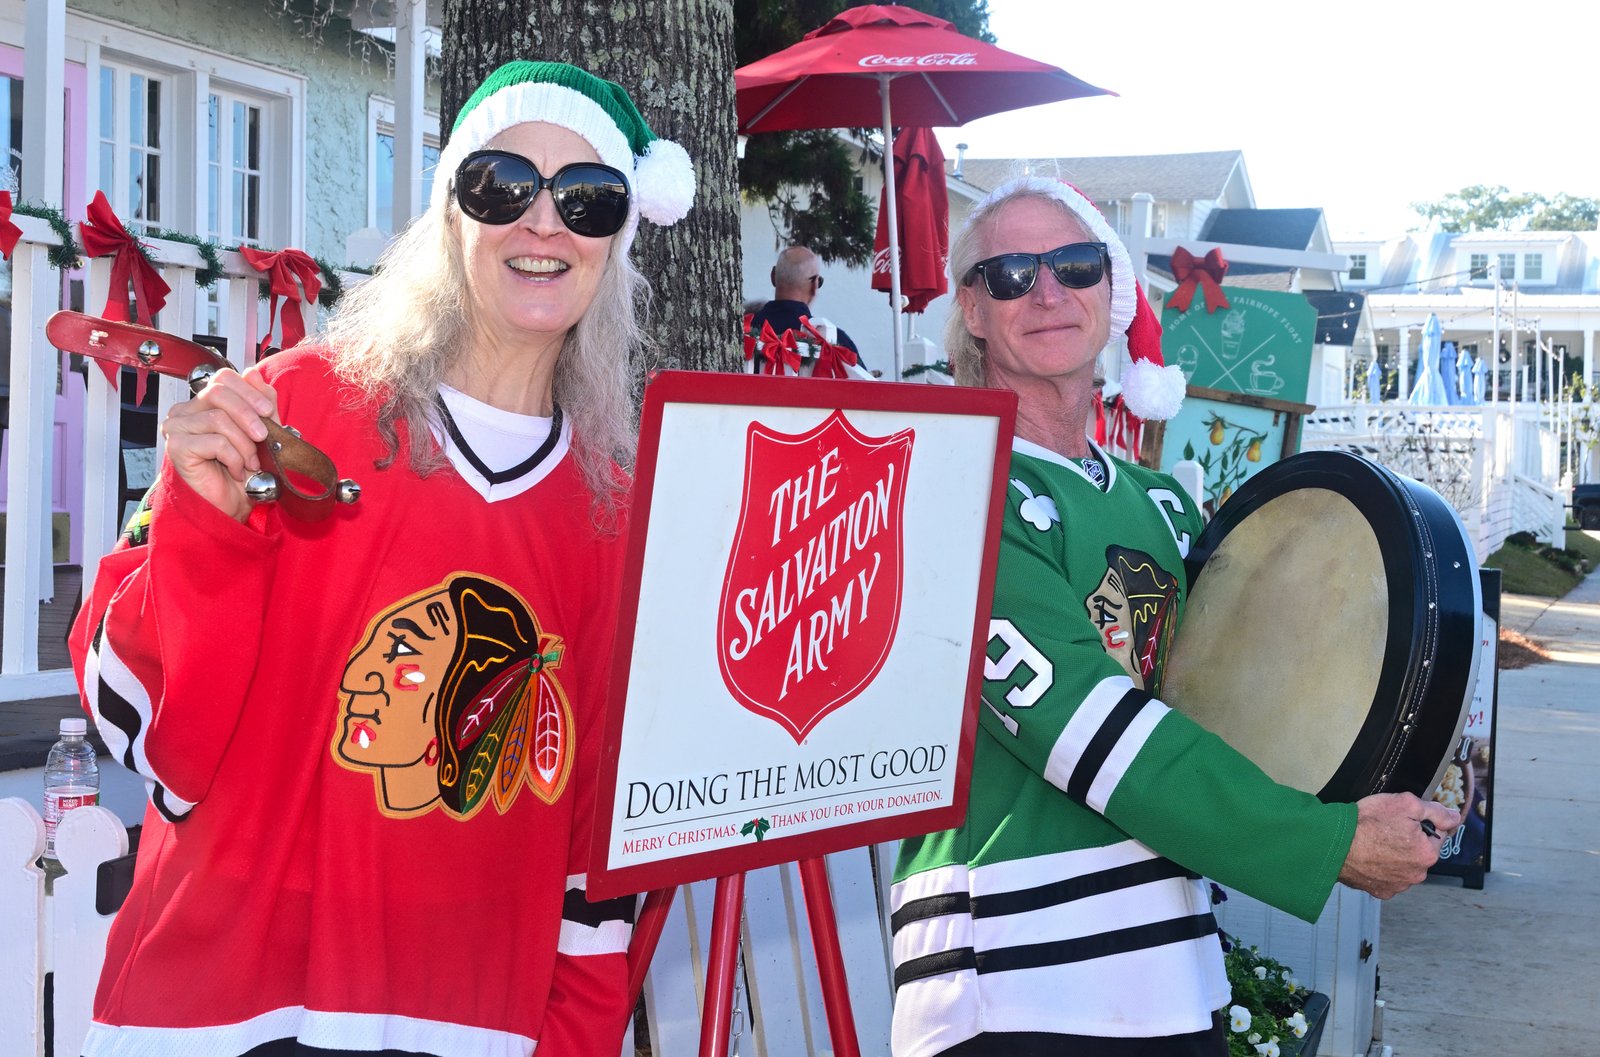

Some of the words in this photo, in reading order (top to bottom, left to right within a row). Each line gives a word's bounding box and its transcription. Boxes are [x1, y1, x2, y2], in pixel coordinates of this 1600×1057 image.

[858, 53, 978, 67] Coca-Cola
[1168, 310, 1192, 331] HOME
[1233, 296, 1280, 319] FAIRHOPE
[1280, 317, 1303, 344] FLOAT
[768, 447, 841, 548] THE
[730, 463, 894, 661] SALVATION
[778, 552, 881, 702] ARMY
[625, 774, 728, 820] DOING
[736, 765, 787, 801] THE
[793, 753, 865, 792] MOST
[871, 744, 946, 780] GOOD
[622, 835, 665, 855] MERRY
[668, 824, 738, 848] CHRISTMAS.
[771, 810, 807, 829] THANK
[810, 806, 832, 821] YOU
[834, 803, 854, 817] FOR
[857, 798, 884, 813] YOUR
[887, 789, 943, 808] DONATION.
